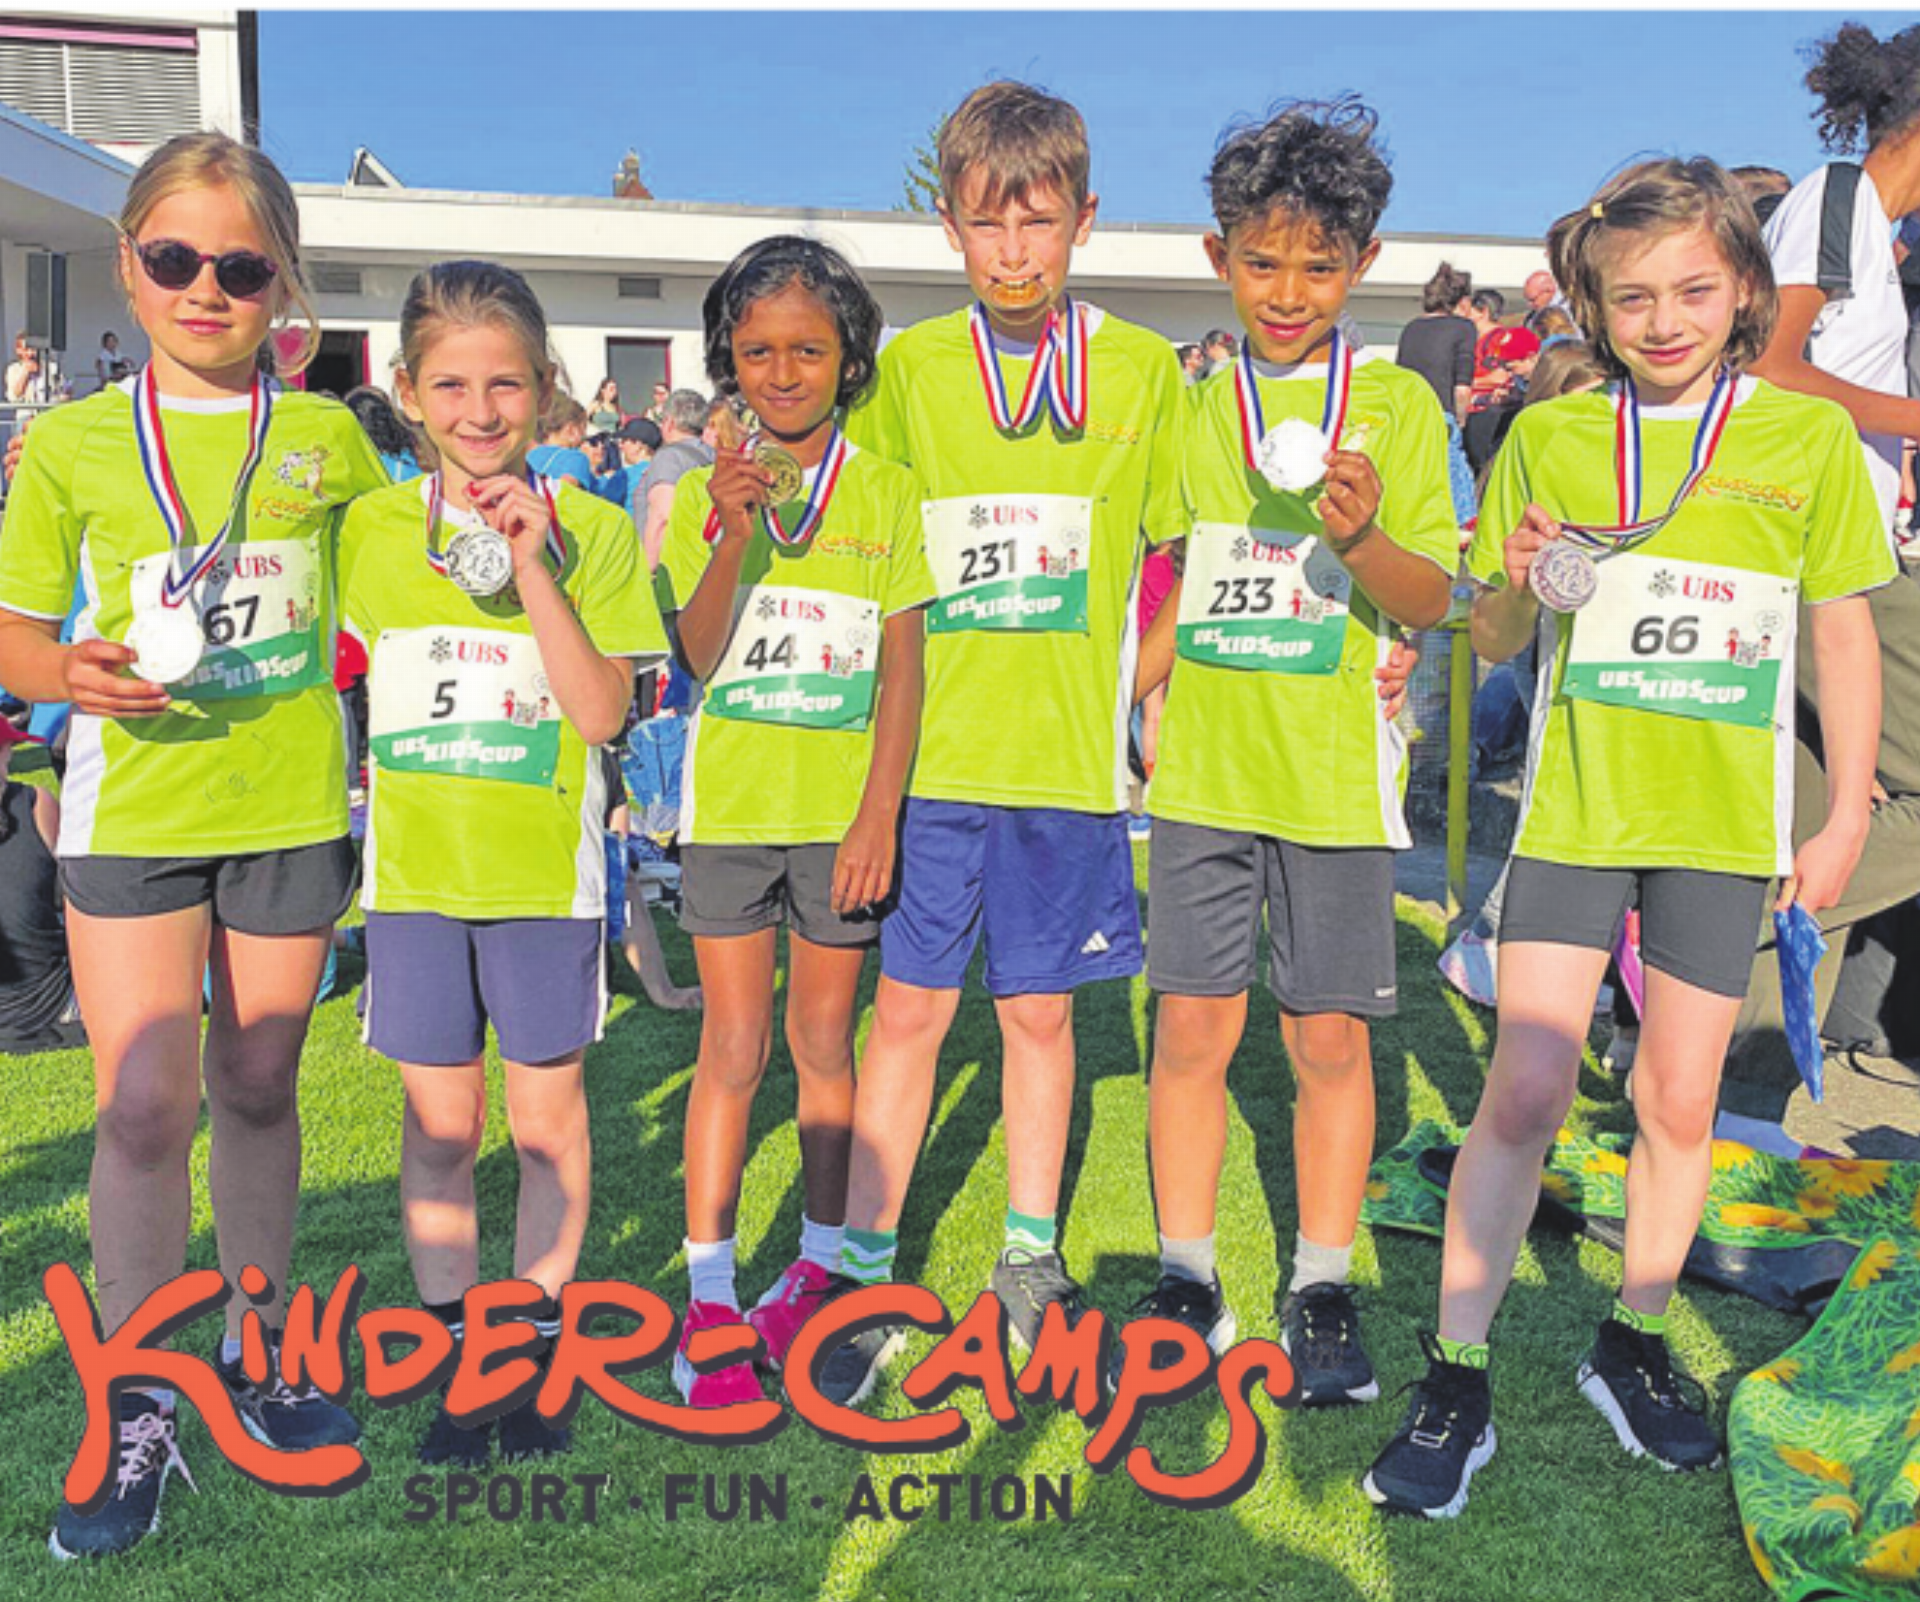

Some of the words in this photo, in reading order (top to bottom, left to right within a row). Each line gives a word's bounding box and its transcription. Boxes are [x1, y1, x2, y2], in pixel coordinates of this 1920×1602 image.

[993, 505, 1039, 526] UBS
[232, 554, 283, 578] UBS
[960, 538, 1017, 585] 231
[1252, 540, 1297, 564] UBS
[1208, 577, 1275, 615] 233
[1682, 575, 1736, 602] UBS
[202, 594, 261, 645] 67
[780, 598, 827, 622] UBS
[1631, 614, 1700, 656] 66
[457, 641, 508, 665] UBS
[743, 633, 799, 671] 44
[430, 679, 457, 719] 5
